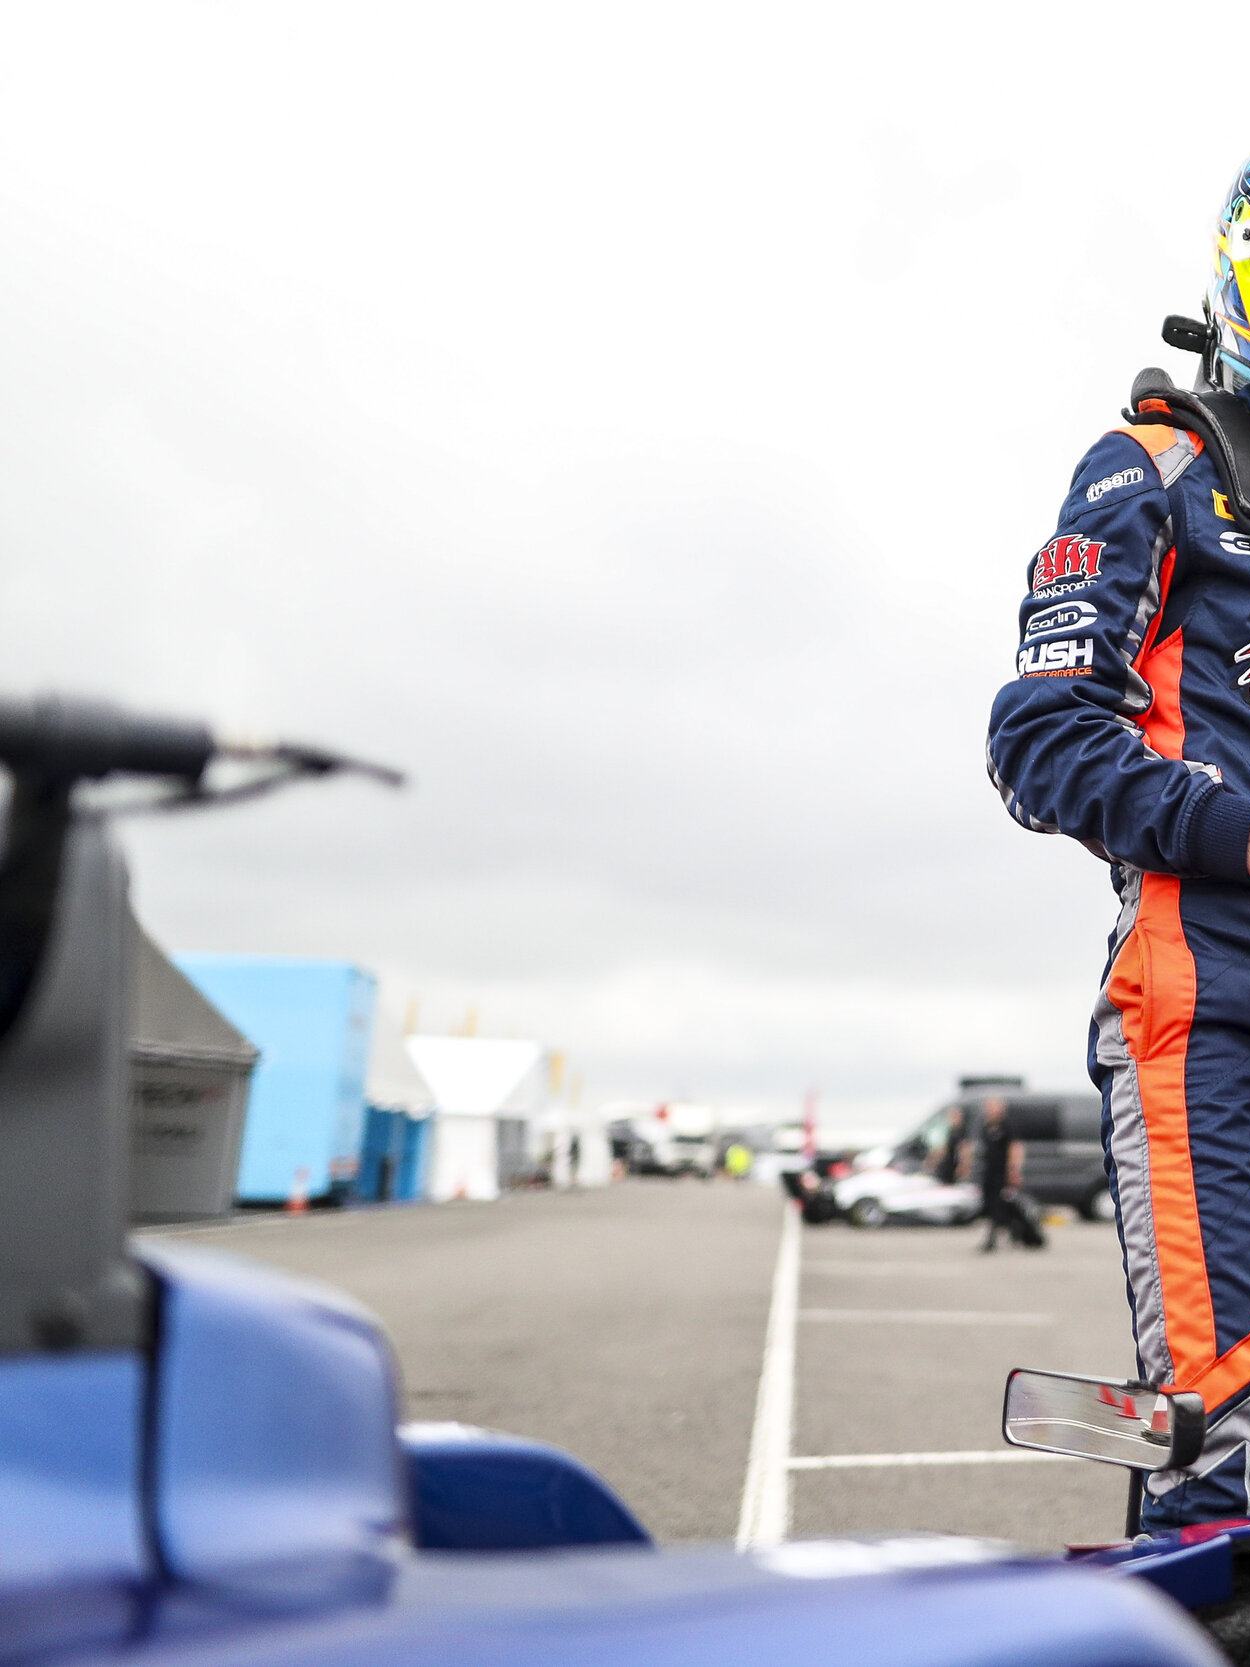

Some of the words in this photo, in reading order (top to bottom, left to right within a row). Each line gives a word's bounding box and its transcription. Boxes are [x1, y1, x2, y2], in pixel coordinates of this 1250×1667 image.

[1086, 467, 1144, 502] freem
[1029, 610, 1079, 631] carlin
[1018, 638, 1094, 676] RUSH
